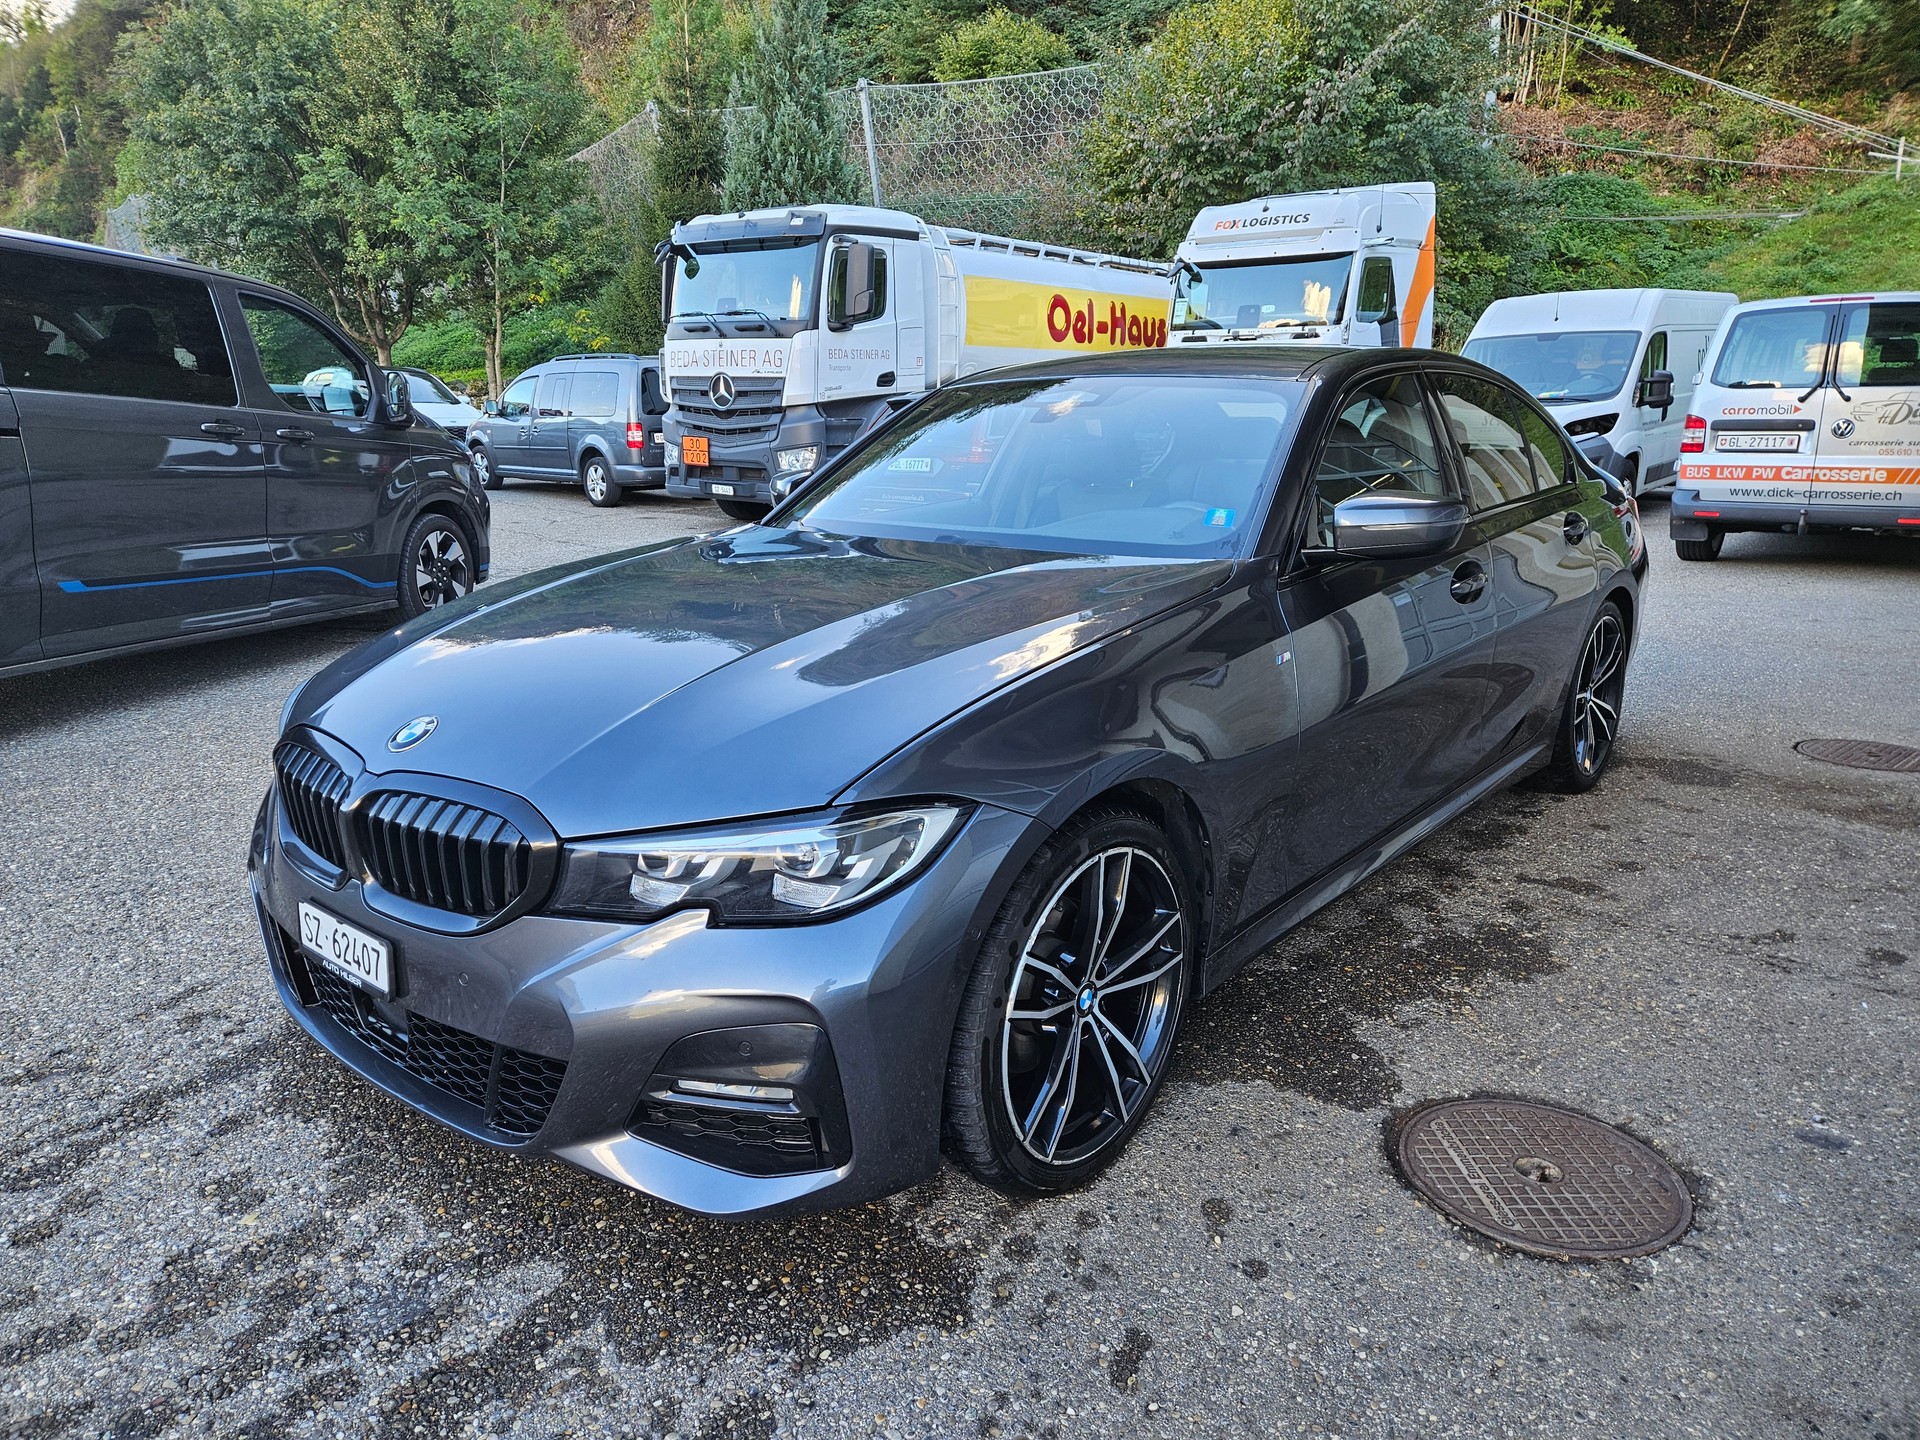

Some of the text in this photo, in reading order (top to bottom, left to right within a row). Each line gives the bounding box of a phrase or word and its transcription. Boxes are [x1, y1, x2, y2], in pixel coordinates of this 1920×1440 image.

[1215, 213, 1310, 231] FOX LOGISTICS
[1047, 293, 1167, 348] Oel-Haus
[671, 349, 783, 368] BEDA STEINER AG
[828, 348, 891, 360] BEDA STEINER AG
[1722, 404, 1793, 416] carromobil
[690, 438, 701, 449] 30
[1728, 437, 1786, 448] GL 27117
[1848, 439, 1904, 447] carrosserie
[685, 452, 707, 464] 1202
[1686, 466, 1887, 481] BUS LKW PW Carrosserie
[1729, 487, 1902, 501] www.dick-carrosserie.ch
[304, 912, 380, 982] SZ 62407
[322, 960, 339, 974] AUTO
